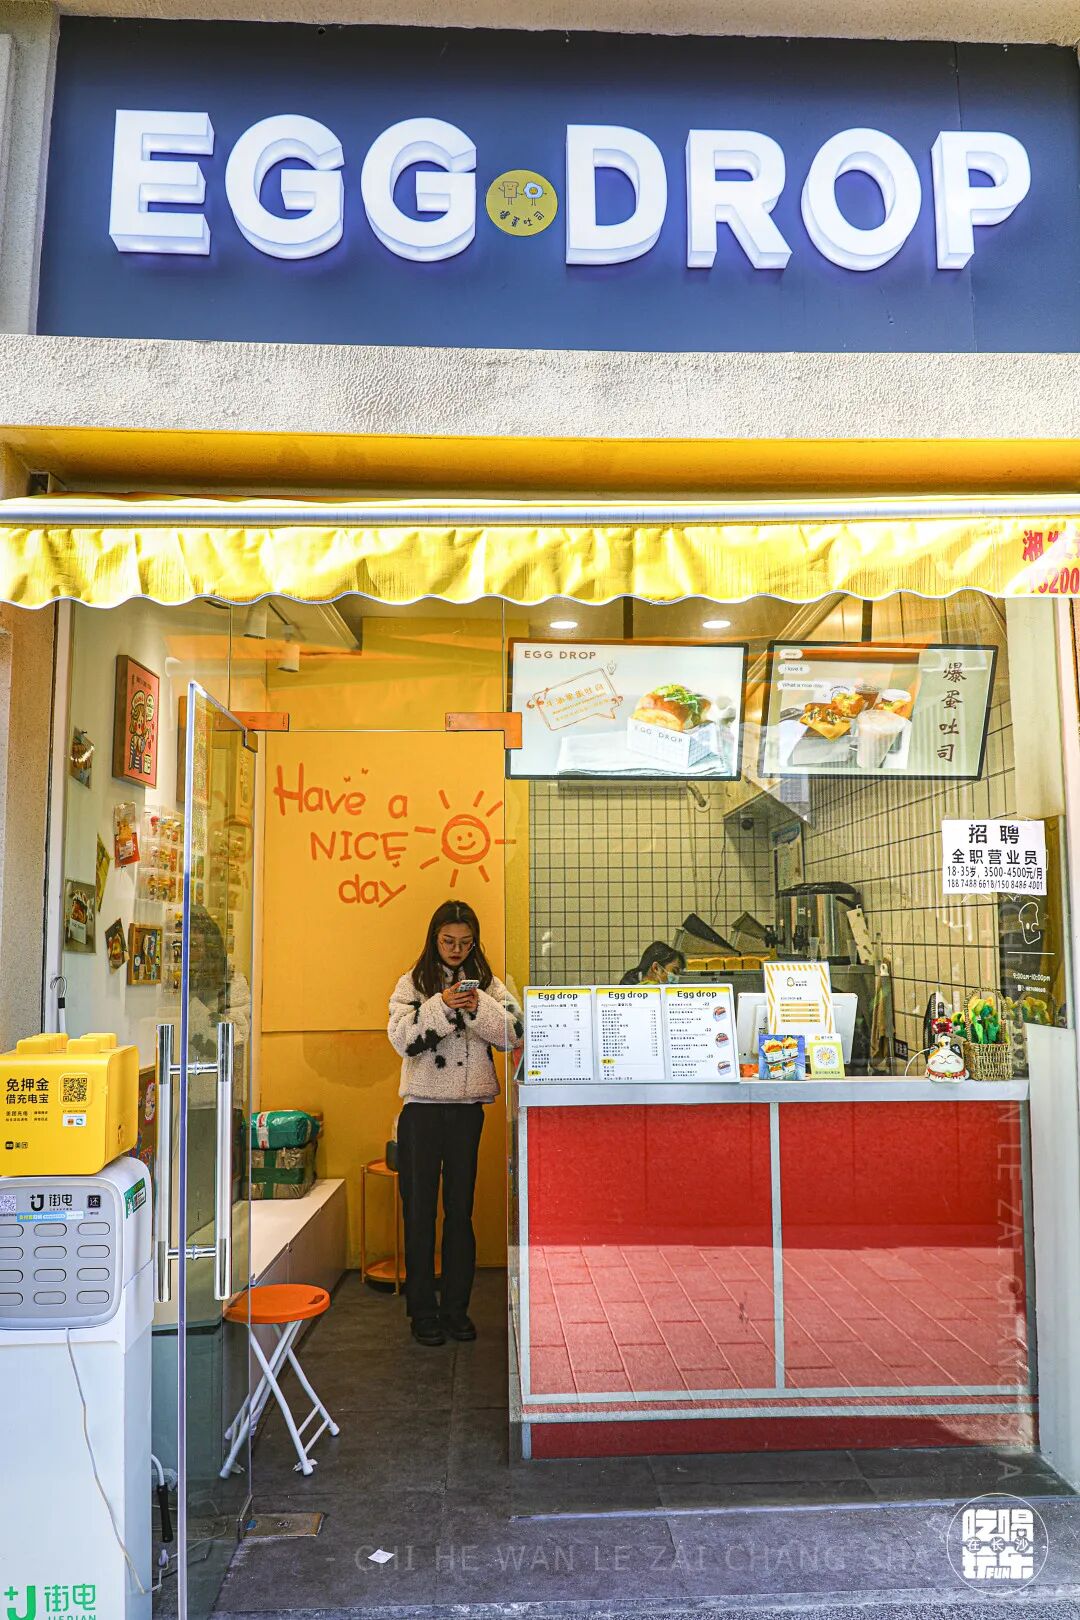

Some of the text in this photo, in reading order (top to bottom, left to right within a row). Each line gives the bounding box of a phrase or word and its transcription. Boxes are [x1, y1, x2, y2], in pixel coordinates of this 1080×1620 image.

[109, 109, 1032, 272] EGG DROP
[524, 650, 596, 660] EGG DROP
[936, 661, 968, 763] 爆蛋吐司
[273, 762, 408, 819] Have a
[968, 824, 1020, 844] 招聘
[310, 830, 409, 862] NICE
[951, 848, 1038, 865] 全职营业员
[338, 873, 407, 908] day
[538, 992, 578, 1000] Egg drop
[608, 991, 649, 1000] Egg drop
[677, 990, 717, 999] Egg drop
[6, 1078, 50, 1092] 免押金
[6, 1094, 49, 1104] 借充电宝
[49, 1194, 73, 1206] 街电
[44, 1584, 96, 1612] 街电
